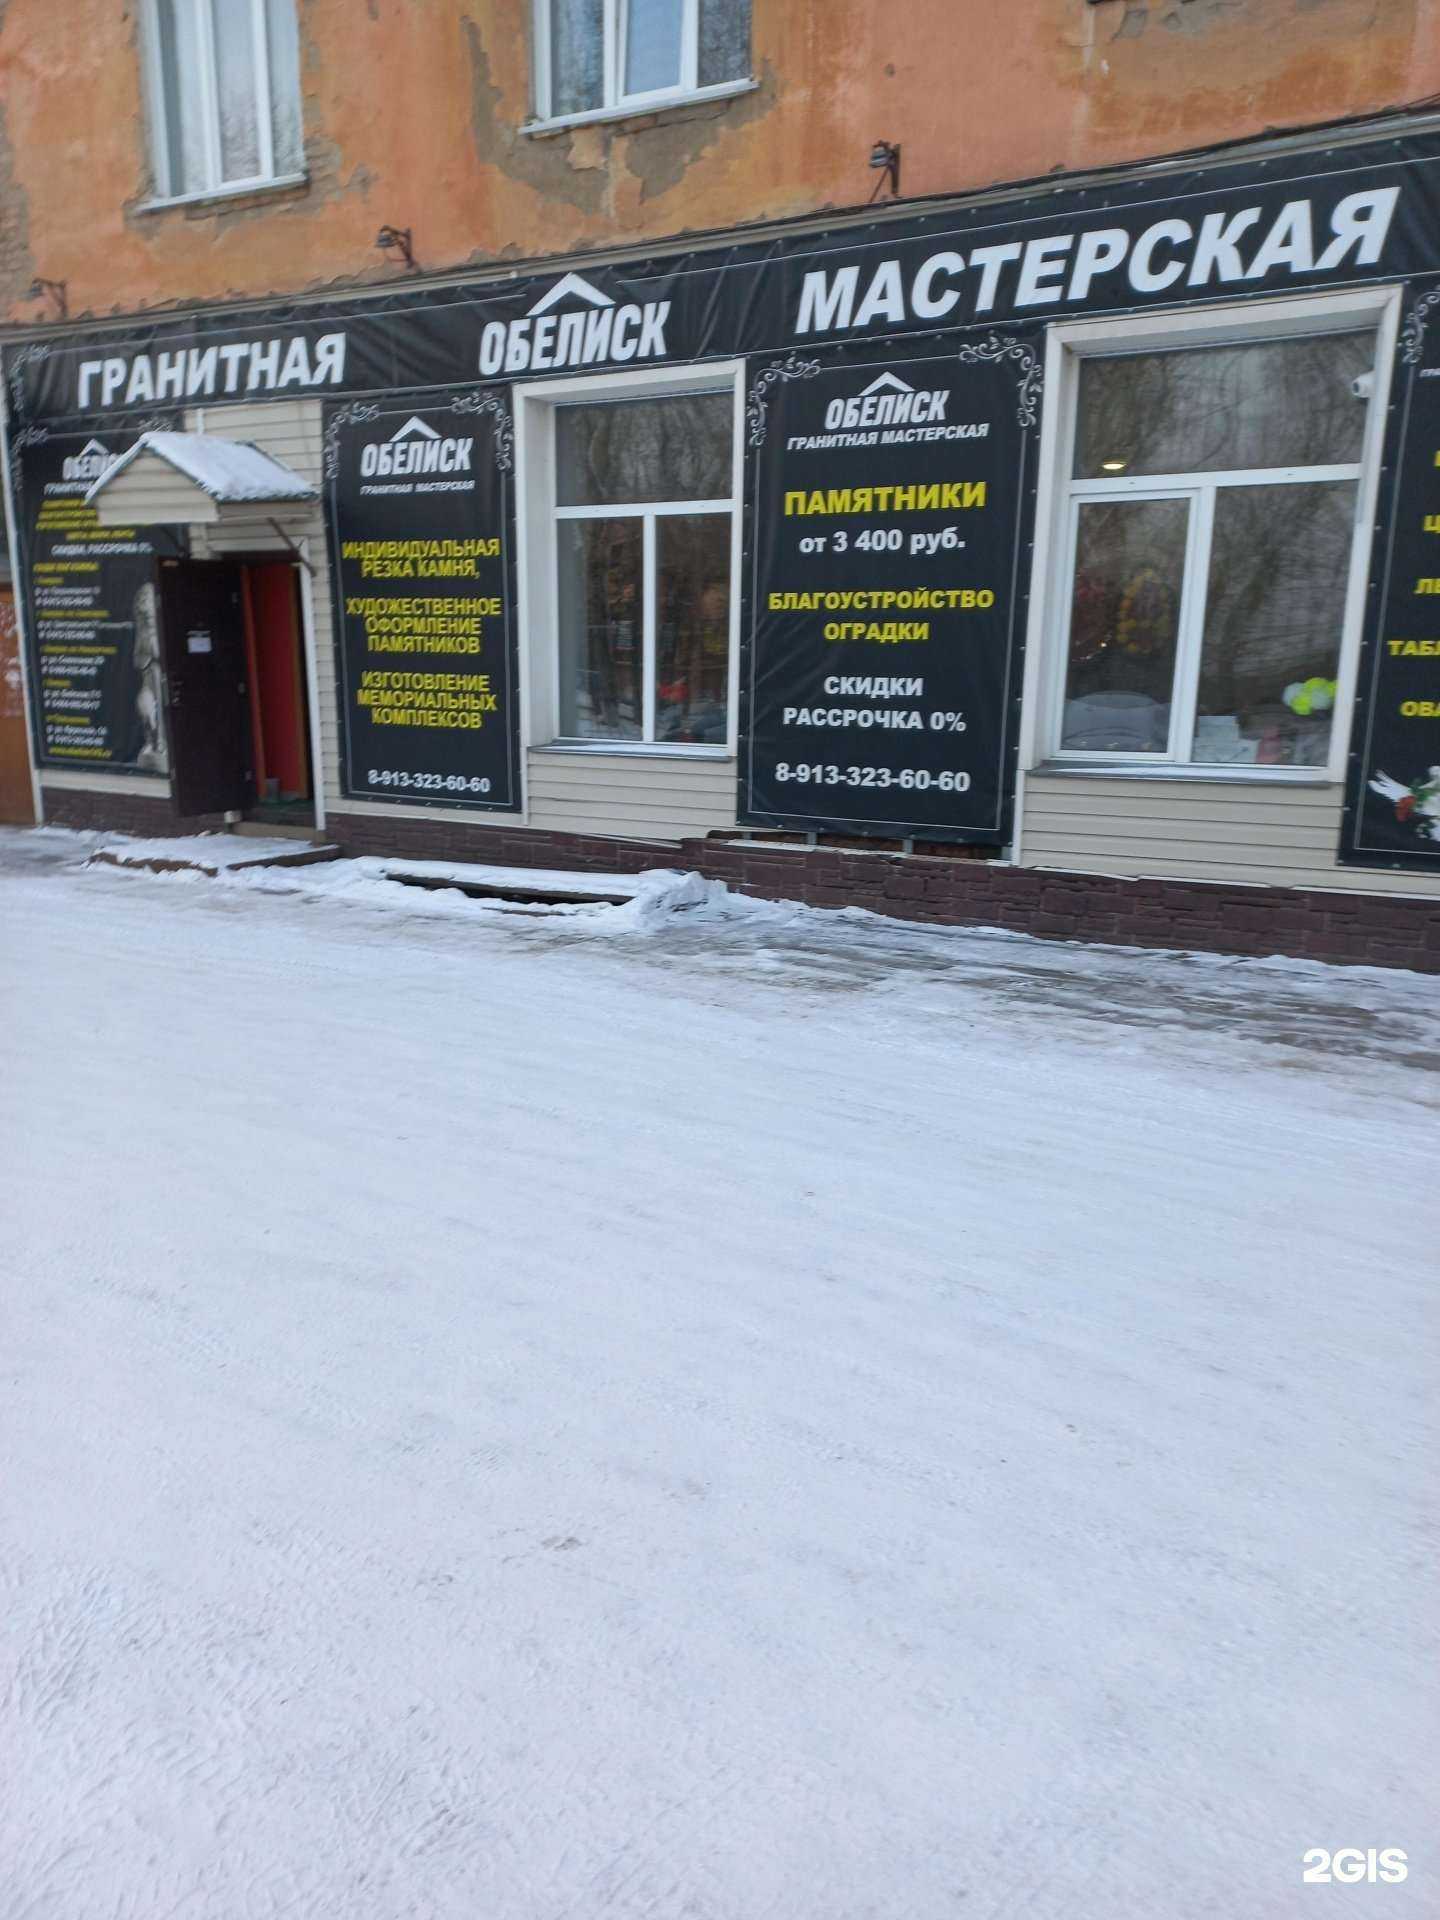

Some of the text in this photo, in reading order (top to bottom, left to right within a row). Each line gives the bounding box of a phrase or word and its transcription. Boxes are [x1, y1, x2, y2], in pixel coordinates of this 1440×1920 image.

[77, 186, 1400, 409] ГРАНИТНАЯ ОБЕЛИСК МАСТЕРСКАЯ
[824, 390, 950, 430] ОБЕЛИСК
[787, 422, 990, 450] ГРАНИТНАЯ МАСТЕРСКАЯ
[360, 438, 474, 477] ОБЕЛИСК
[360, 480, 476, 495] ГРАНИТНАЯ МАСТЕРСКАЯ
[784, 481, 987, 516] ПАМЯТНИКИ
[342, 538, 501, 560] ИНДИВИДУАЛЬНАЯ
[799, 526, 966, 555] от 3 400 руб.
[361, 559, 481, 580] РЕЗКА КАМНЯ,
[346, 597, 502, 617] ХУДОЖЕСТВЕННОЕ
[768, 587, 995, 611] БЛАГОУСТРОЙСТВО
[365, 616, 482, 635] ОФОРМЛЕНИЕ
[823, 622, 930, 643] ОГРАДКИ
[368, 635, 481, 654] ПАМЯТНИКОВ
[362, 671, 490, 691] ИЗГОТОВЛЕНИЕ
[823, 675, 924, 699] СКИДКИ
[357, 689, 497, 711] МЕМОРИАЛЬНЫХ
[371, 707, 482, 729] КОМПЛЕКСОВ
[783, 707, 967, 732] РАССРОЧКА 0%
[367, 769, 491, 793] 8-913-323-60-60
[775, 762, 971, 792] 8-913-323-60-60
